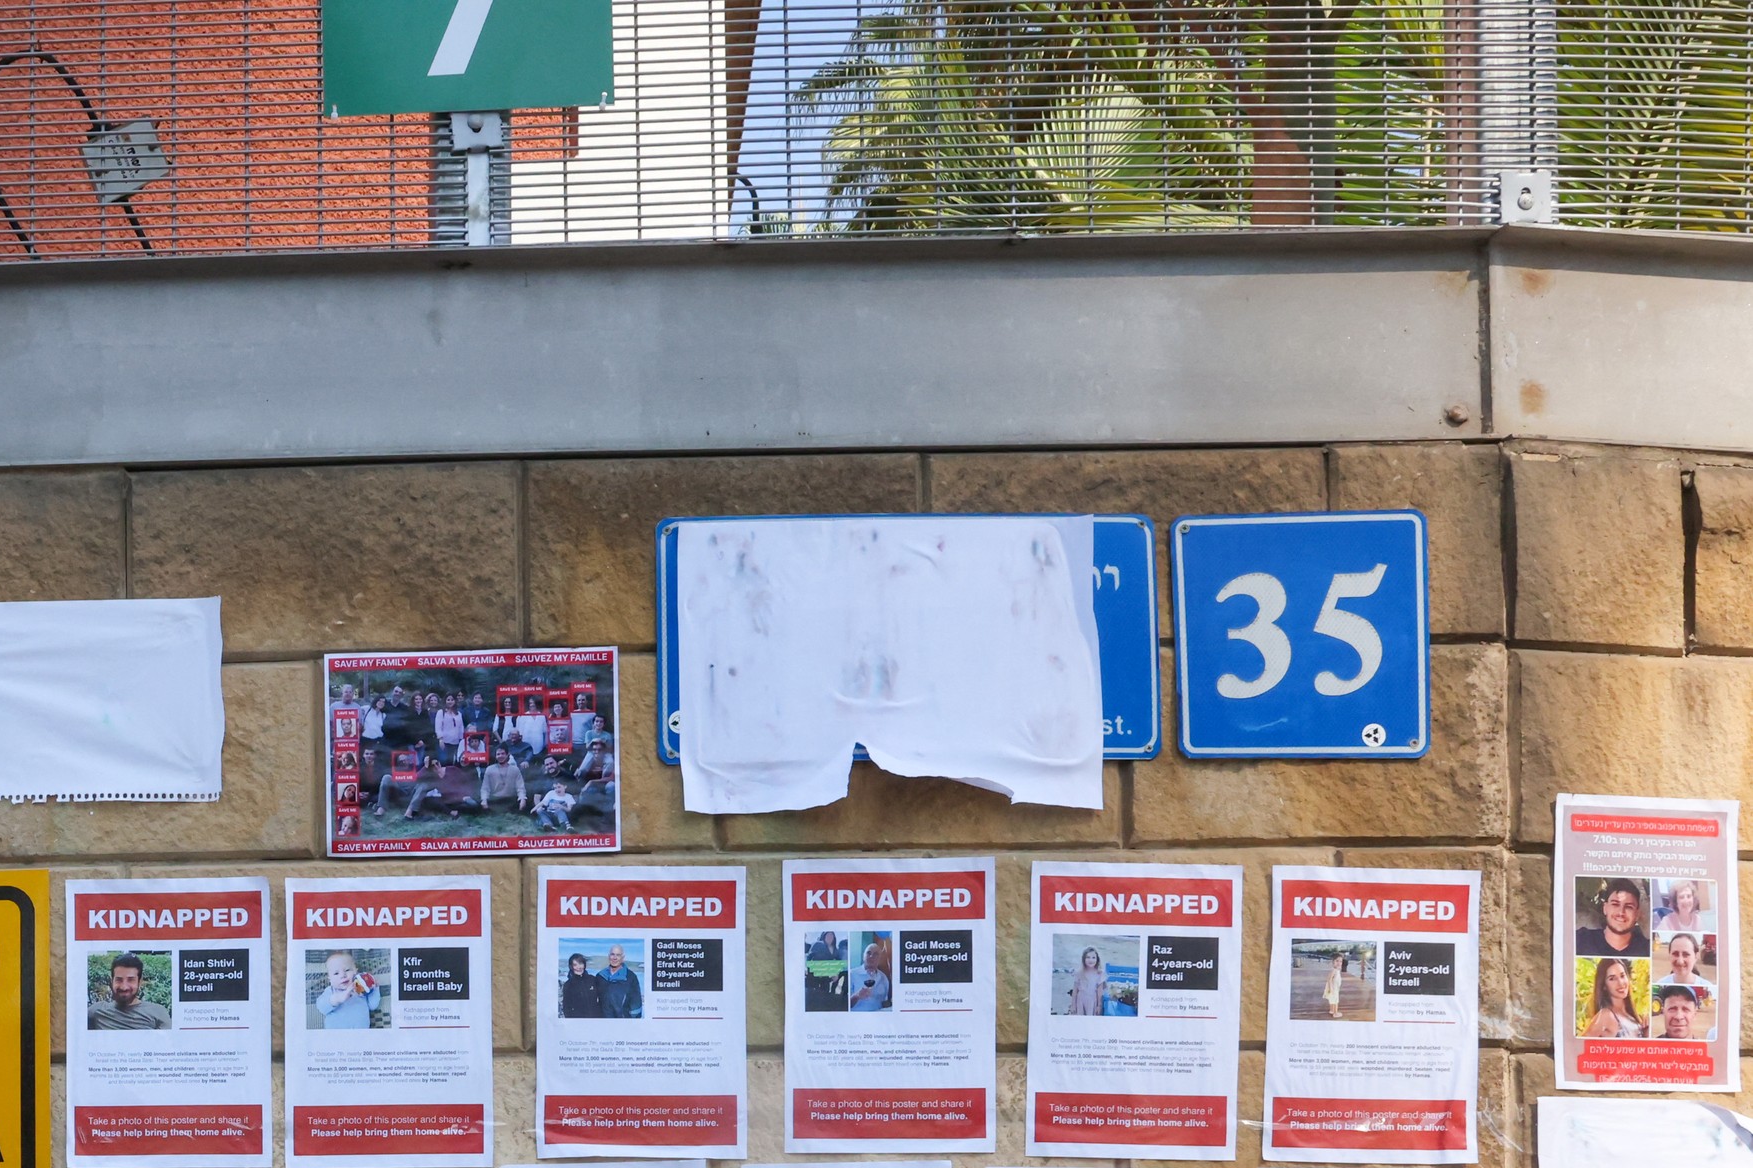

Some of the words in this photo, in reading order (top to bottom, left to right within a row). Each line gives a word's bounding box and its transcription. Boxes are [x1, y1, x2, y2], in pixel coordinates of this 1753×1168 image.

[1216, 563, 1388, 699] 35
[470, 656, 505, 664] FAMILIA
[554, 654, 568, 662] MY
[571, 653, 607, 661] FAMILLE
[335, 660, 357, 668] SAVE
[1103, 715, 1132, 736] st.
[379, 842, 411, 850] FAMILY
[518, 840, 554, 848] SAUVEZ
[557, 839, 571, 847] MY
[573, 838, 610, 846] FAMILLE
[806, 888, 972, 910] KIDNAPPED
[1054, 892, 1219, 915] KIDNAPPED
[560, 897, 723, 917] KIDNAPPED
[1293, 897, 1456, 921] KIDNAPPED
[88, 908, 249, 929] KIDNAPPED
[306, 906, 468, 928] KIDNAPPED
[905, 941, 926, 949] Gadi
[930, 941, 960, 949] Moses
[404, 957, 422, 965] Kfir
[905, 953, 967, 963] 80-years-old
[184, 960, 204, 968] Idan
[208, 959, 234, 967] Shtivi
[404, 970, 409, 978] 9
[413, 969, 450, 978] months
[905, 965, 933, 973] Israeli
[184, 971, 242, 981] 28-years-old
[184, 983, 212, 991] Israeli
[404, 982, 434, 991] Israeli
[438, 982, 462, 992] Baby
[808, 1100, 827, 1108] Take
[838, 1100, 862, 1108] photo
[811, 1112, 840, 1120] Please
[844, 1112, 862, 1121] help
[866, 1112, 888, 1122] bring
[891, 1112, 914, 1120] them
[917, 1112, 942, 1120] home
[944, 1112, 967, 1120] alive.
